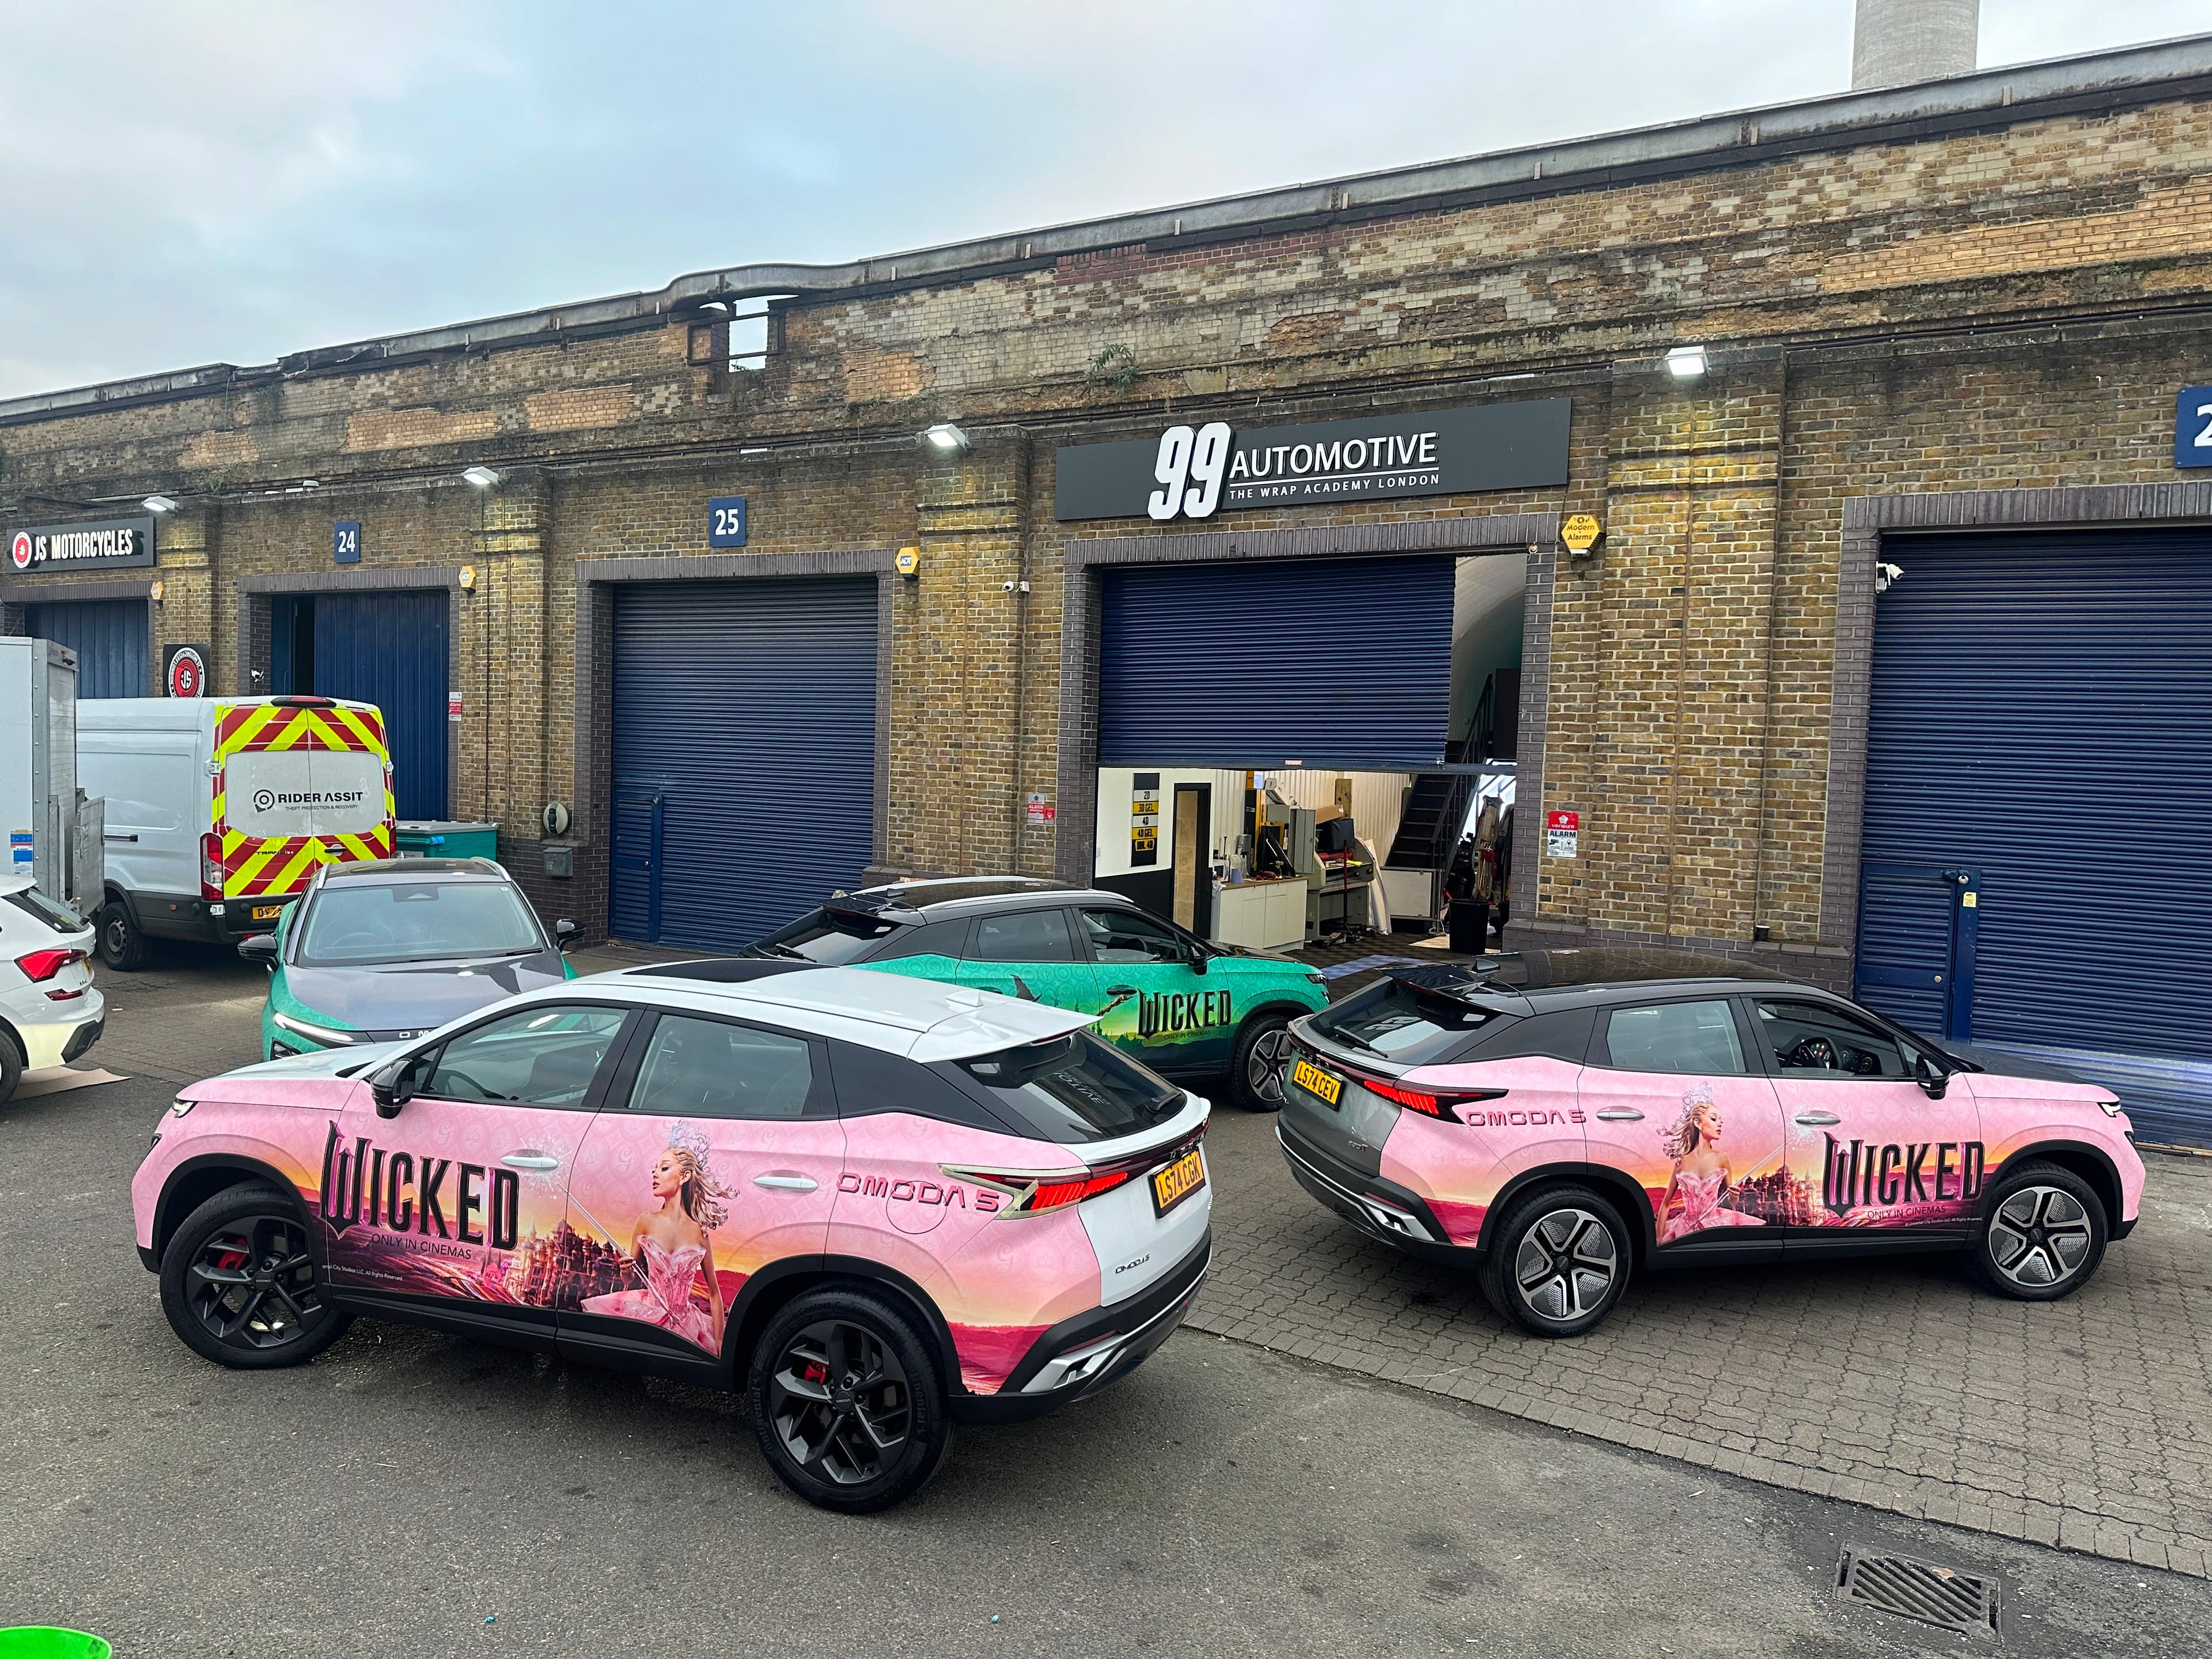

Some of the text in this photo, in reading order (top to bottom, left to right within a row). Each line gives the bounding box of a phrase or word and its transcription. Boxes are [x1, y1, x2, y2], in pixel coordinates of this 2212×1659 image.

[2194, 404, 2212, 446] 2
[1147, 422, 1439, 520] 99 AUTOMOTIVE
[1230, 474, 1440, 500] THE WRAP ACADEMY LONDON
[715, 509, 739, 536] 25
[35, 536, 47, 561] JS
[51, 528, 133, 560] MOTORCYCLES
[338, 531, 355, 553] 24
[278, 791, 363, 804] RIDER ASSIT
[1138, 803, 1154, 812] 3D GEL
[1143, 791, 1150, 800] 2D
[1142, 816, 1149, 825] 4D
[1144, 828, 1154, 837] GEL
[1550, 830, 1576, 838] ALARM
[1137, 988, 1232, 1040] WICKED
[1187, 1030, 1211, 1038] CINEMAS
[1297, 1063, 1337, 1101] LS74 CEV
[1466, 1109, 1586, 1127] OMODA 5
[318, 1120, 520, 1250] WICKED
[1158, 1169, 1184, 1204] LS74
[1182, 1158, 1200, 1187] CGK
[1823, 1131, 1985, 1219] WICKED
[836, 1172, 1000, 1213] OMODA 5
[1867, 1205, 1946, 1219] ONLY IN CINEMAS
[372, 1233, 472, 1260] ONLY IN CINEMAS
